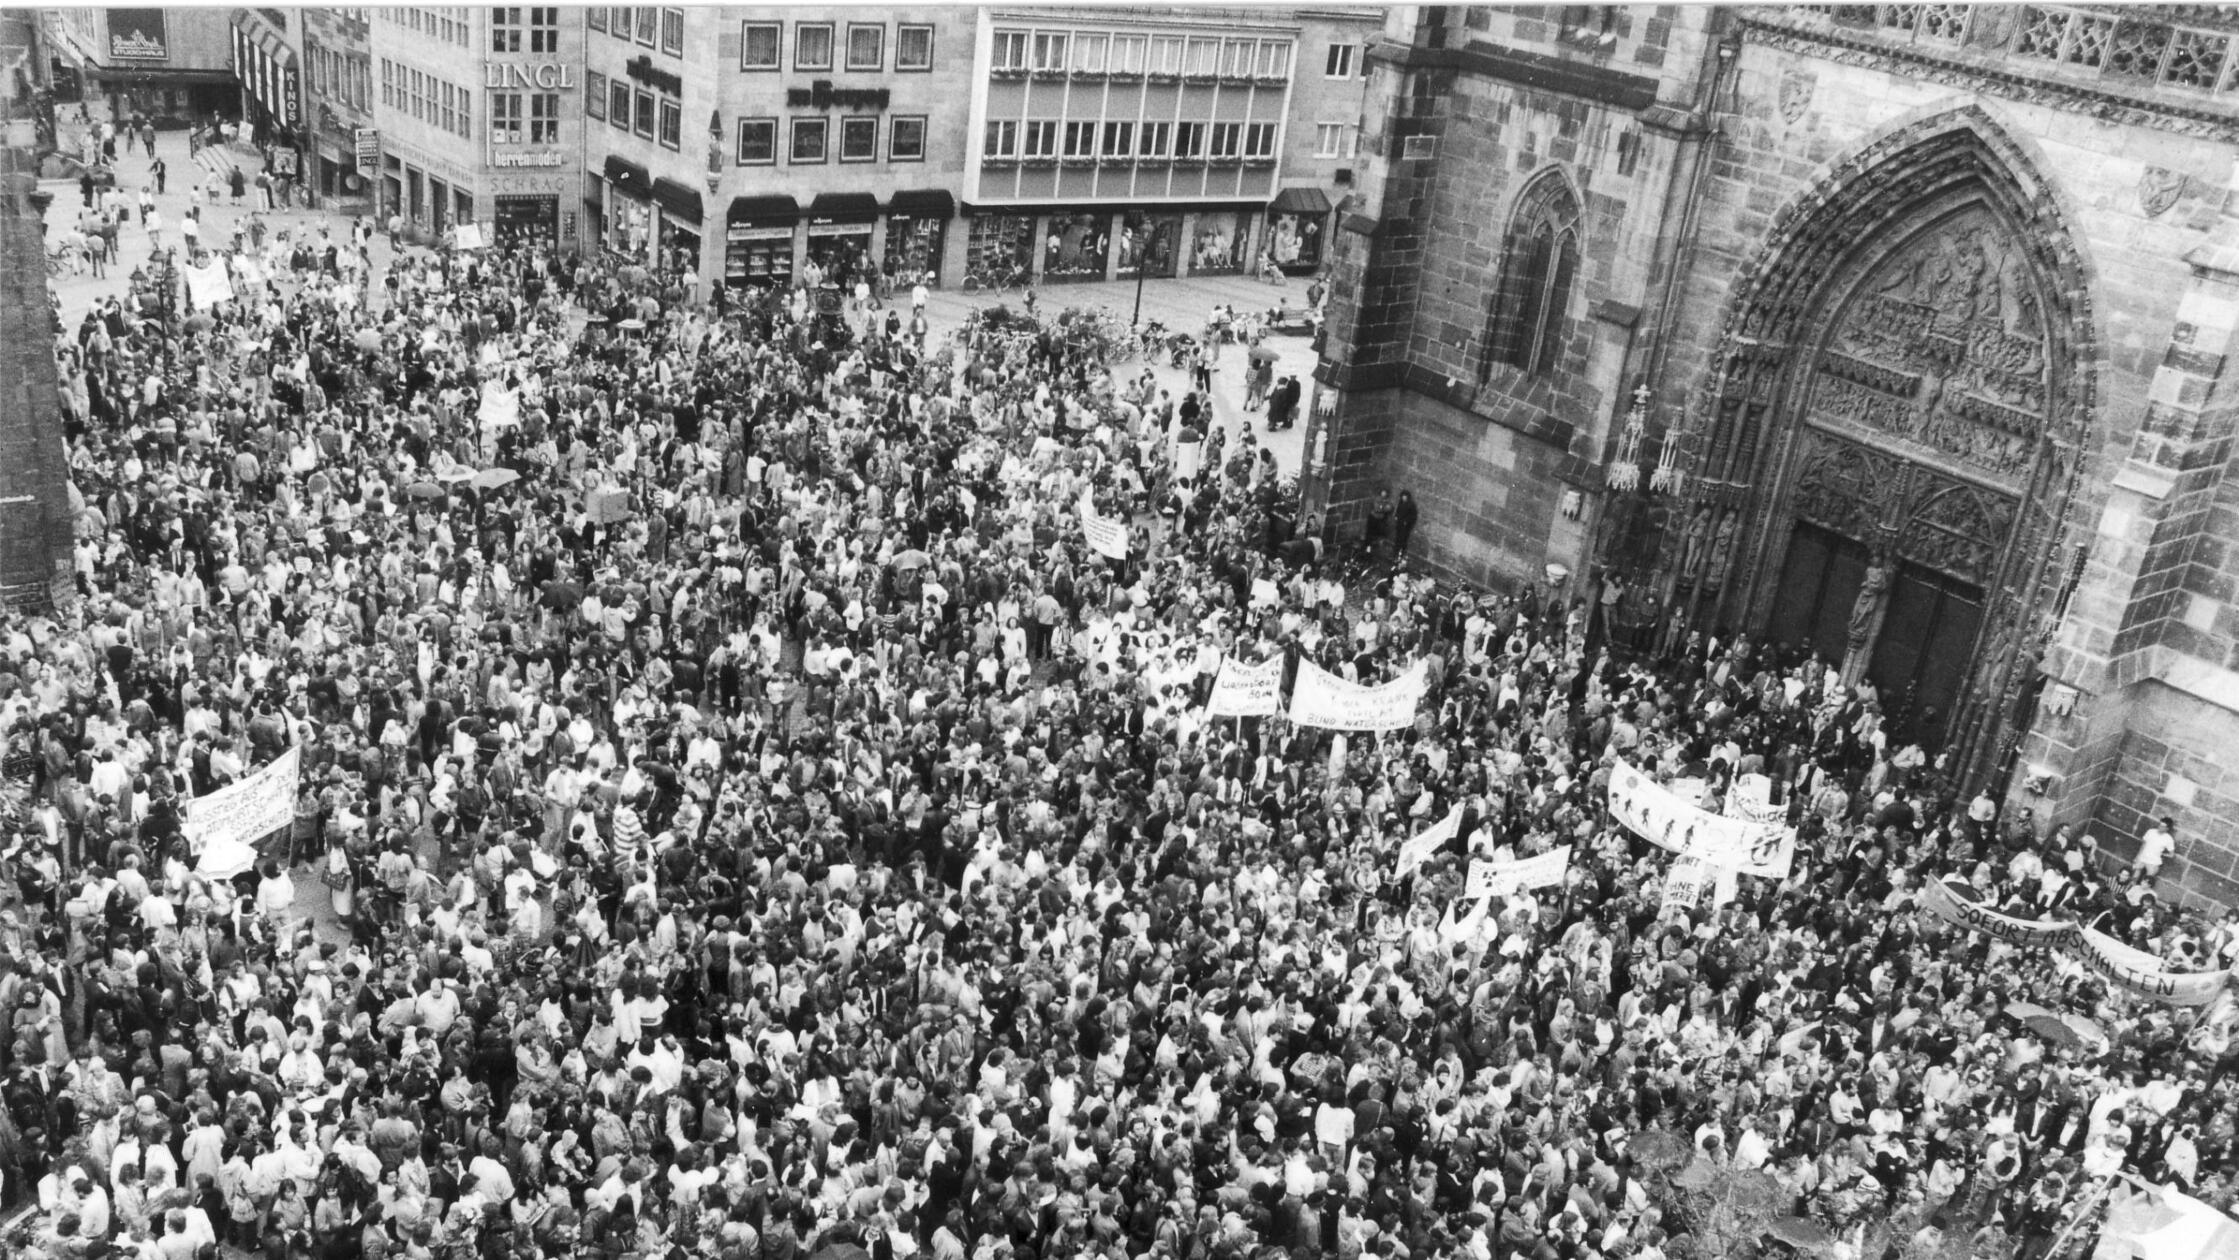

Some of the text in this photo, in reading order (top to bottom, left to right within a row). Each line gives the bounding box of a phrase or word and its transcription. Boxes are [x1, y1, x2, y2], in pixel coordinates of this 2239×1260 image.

[485, 63, 574, 89] LINGL
[286, 71, 297, 122] KINOS
[494, 151, 562, 168] herrenmoden
[490, 177, 565, 192] SCHRAG
[1306, 712, 1337, 726] BUND
[1956, 902, 2176, 997] SOFORT ABSCHALTEN
